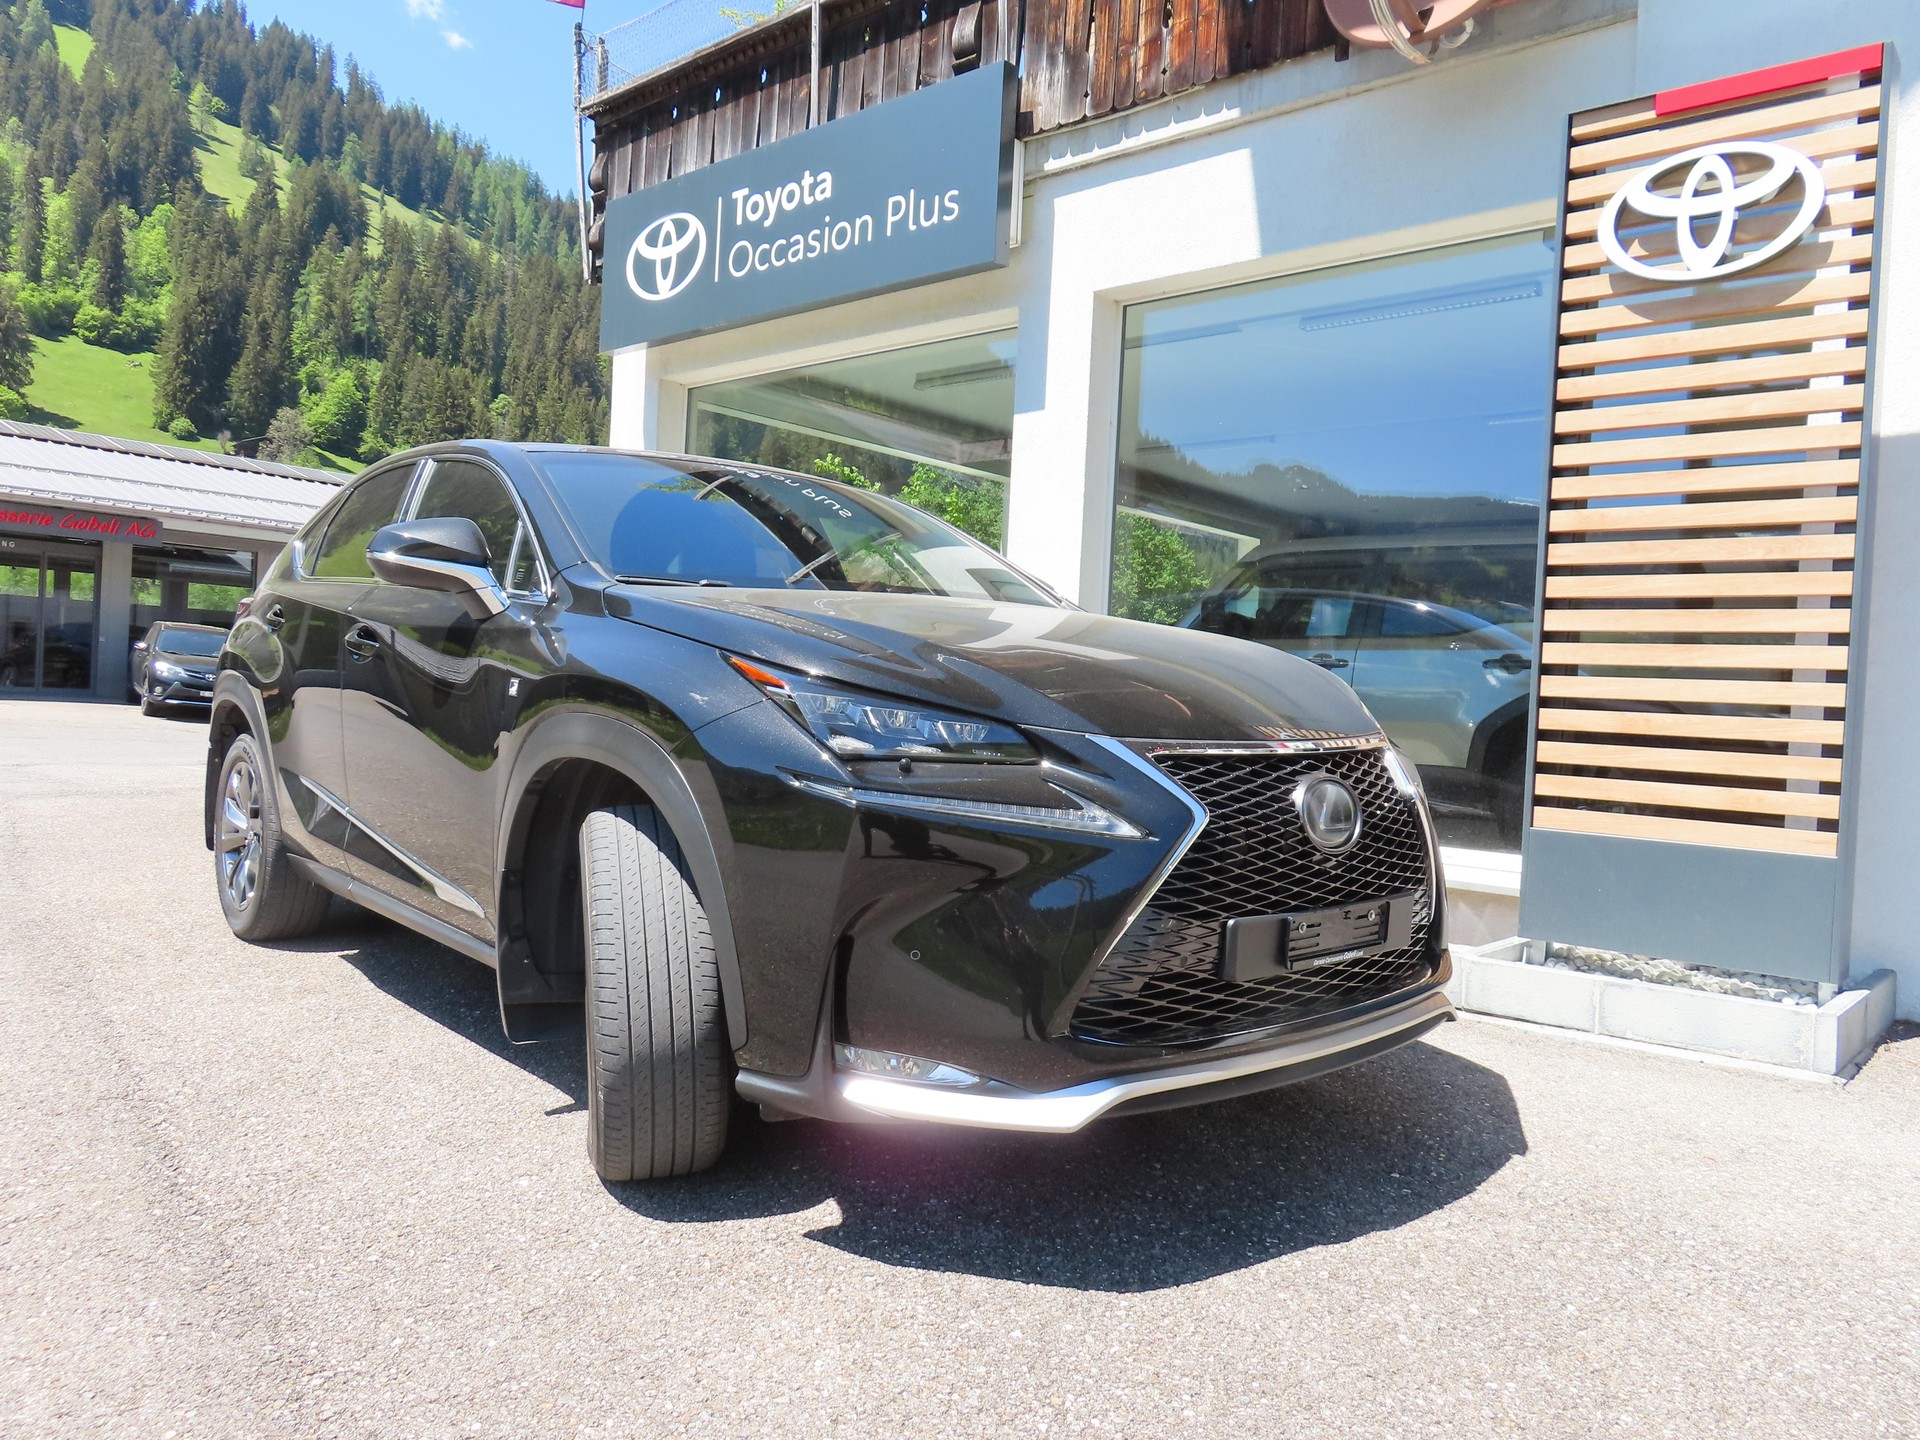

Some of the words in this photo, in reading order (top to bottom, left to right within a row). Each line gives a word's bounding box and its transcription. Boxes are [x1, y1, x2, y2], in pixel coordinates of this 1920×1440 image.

[731, 169, 833, 228] Toyota
[728, 214, 873, 277] Occasion
[885, 188, 960, 238] Plus
[60, 513, 121, 535] Gobeli
[125, 521, 156, 538] AG
